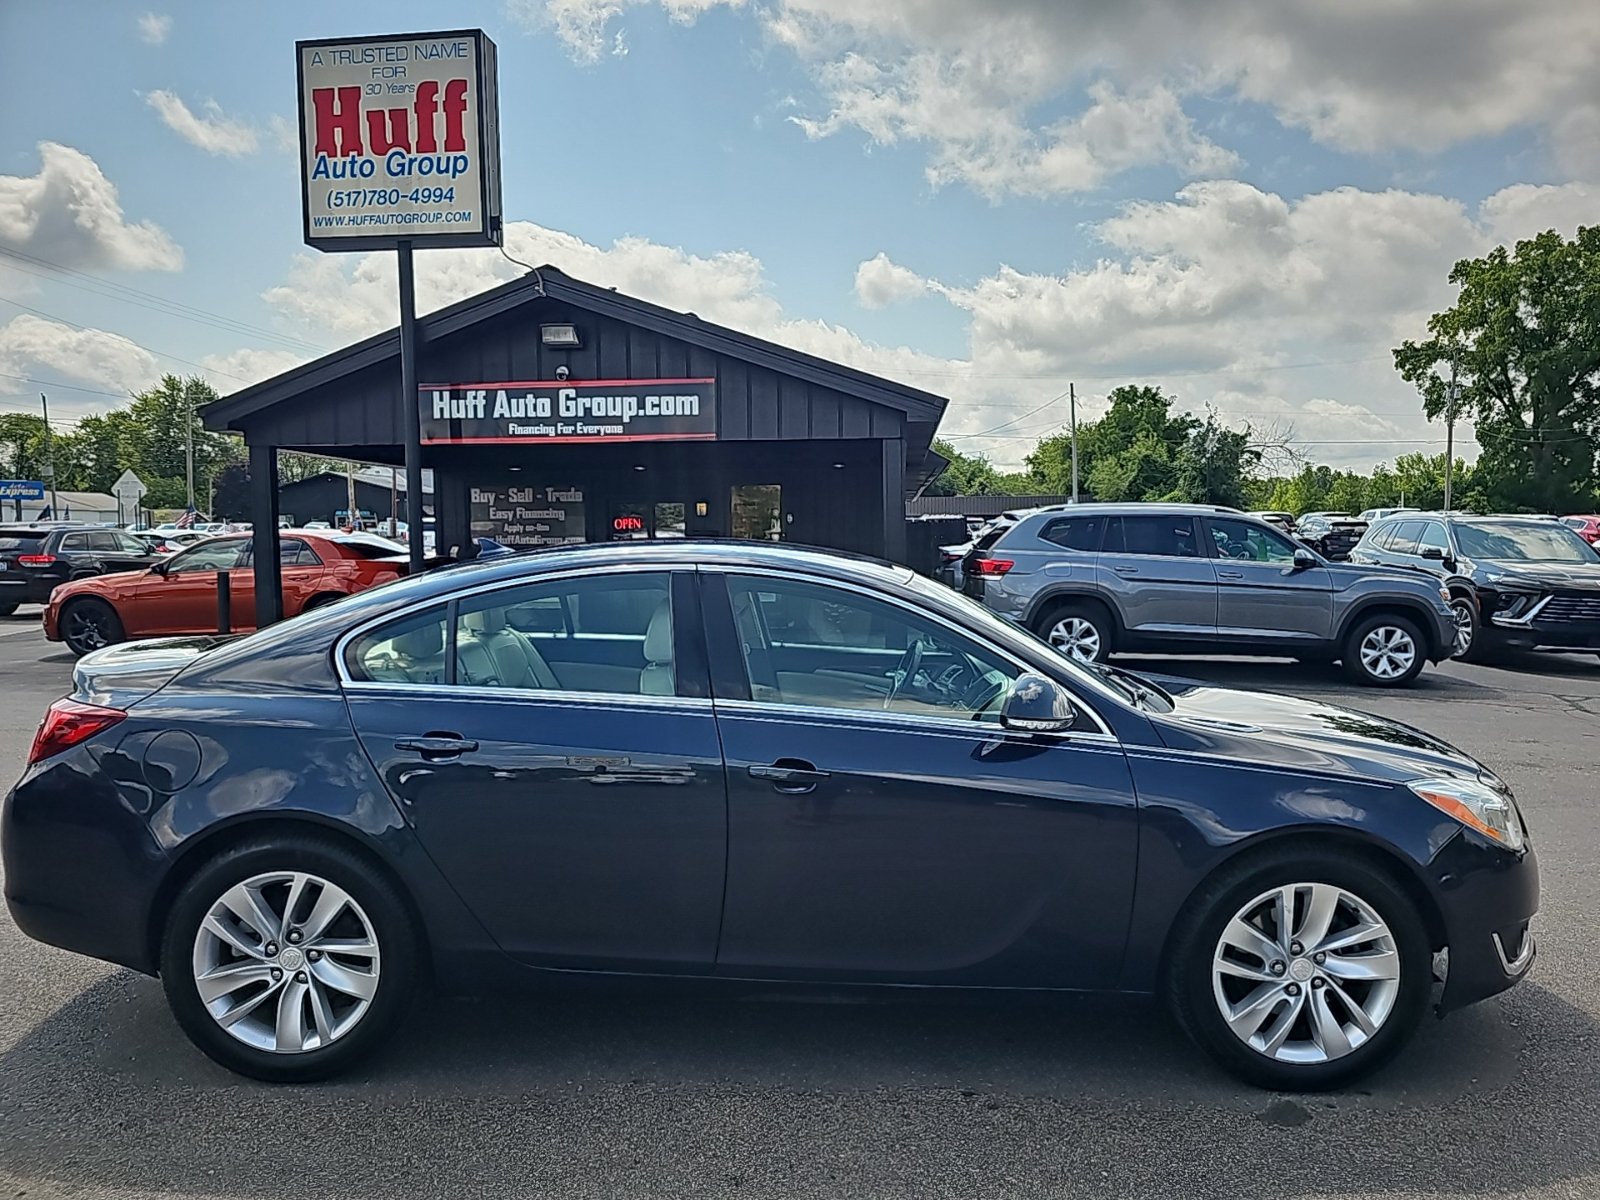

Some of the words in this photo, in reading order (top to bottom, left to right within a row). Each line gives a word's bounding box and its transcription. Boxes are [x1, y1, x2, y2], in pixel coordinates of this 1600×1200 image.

[310, 51, 324, 67] A
[329, 46, 409, 65] TRUSTED
[415, 42, 468, 59] NAME
[371, 66, 407, 79] FOR
[365, 83, 382, 95] 30
[386, 82, 416, 95] Years
[312, 78, 468, 159] Huff
[311, 155, 375, 180] Auto
[386, 151, 469, 179] Group
[327, 187, 455, 209] (517)780-4994
[313, 211, 472, 228] WWW.HUFFAUTOGROUP.COM
[432, 391, 486, 420] Huff
[493, 390, 551, 419] Auto
[558, 388, 700, 424] Group.com
[508, 422, 556, 437] Financing
[557, 422, 575, 436] For
[576, 422, 623, 437] Everyone
[0, 486, 40, 497] Express
[470, 487, 496, 506] Buy
[508, 487, 534, 503] Sell
[545, 487, 583, 503] Trade
[489, 507, 514, 521] Easy
[614, 518, 641, 530] OPEN
